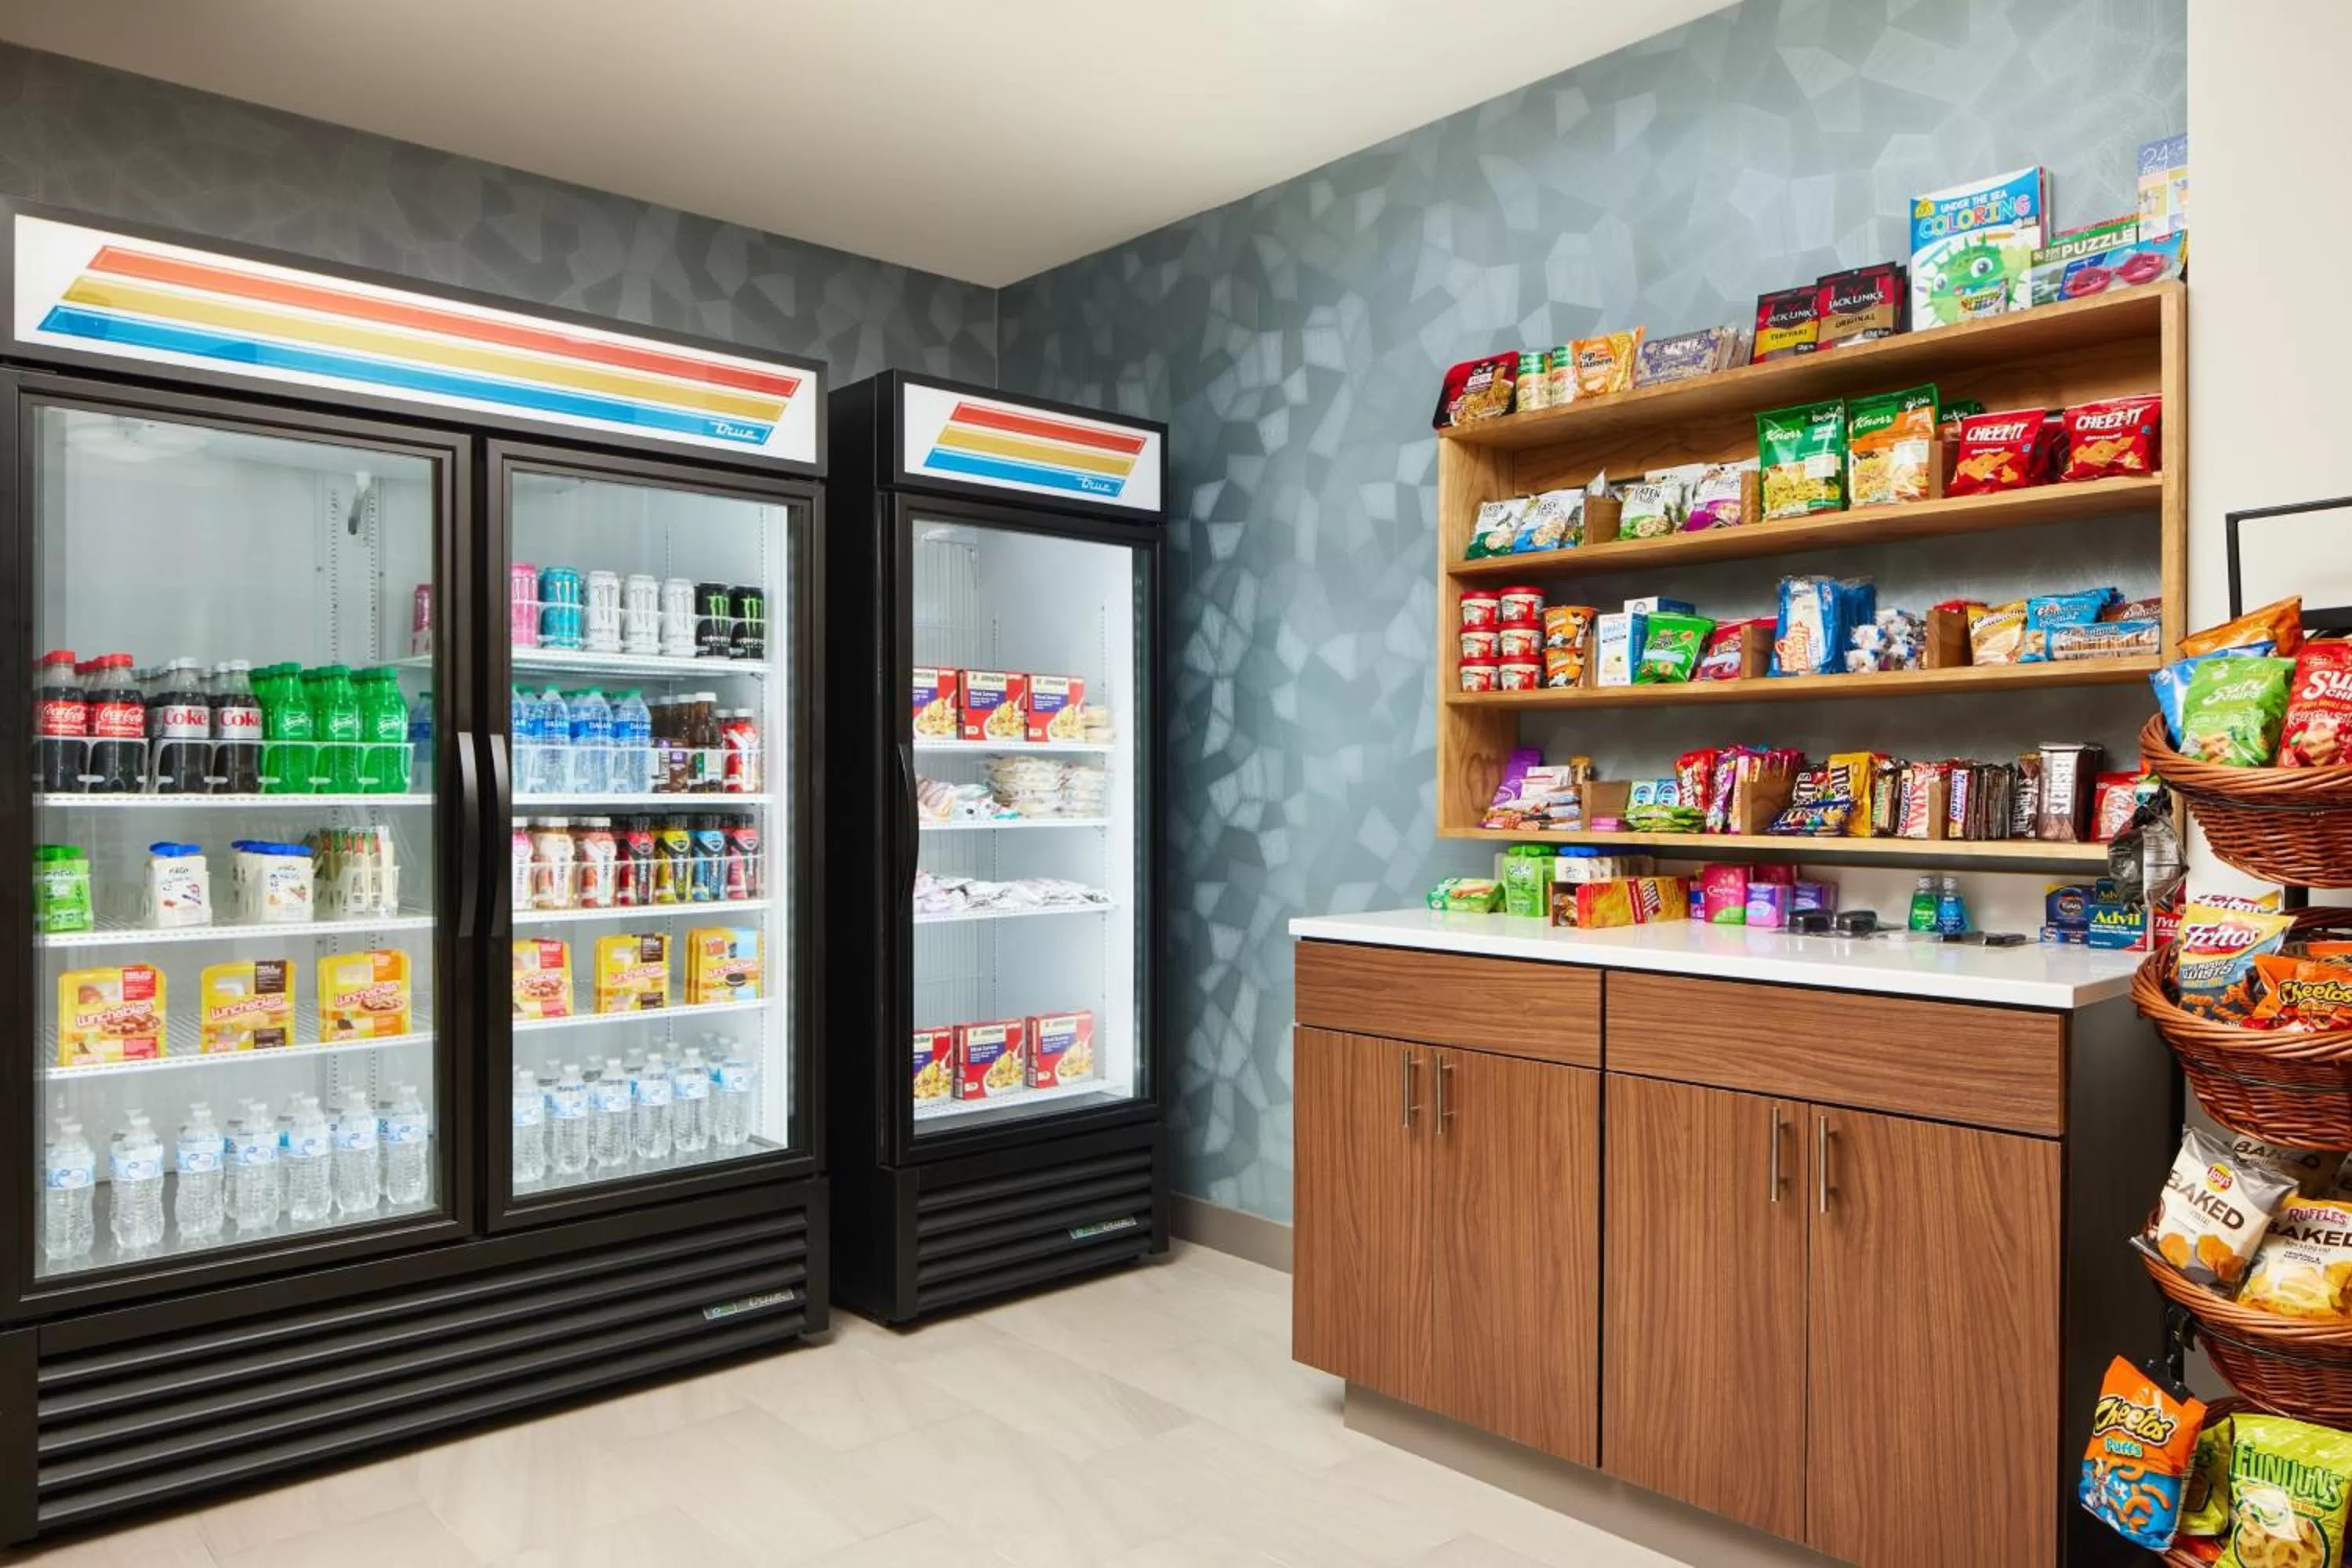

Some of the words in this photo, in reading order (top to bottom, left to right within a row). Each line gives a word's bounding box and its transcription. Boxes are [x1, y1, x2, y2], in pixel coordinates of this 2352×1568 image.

[1973, 194, 1988, 205] THE
[1991, 189, 2008, 200] SEA
[1919, 194, 2031, 238] COLORING
[2062, 228, 2133, 258] PUZZLE
[1828, 296, 1853, 310] JACK
[1853, 291, 1885, 303] LINK'S
[1835, 313, 1875, 328] ORIGINAL
[1855, 414, 1893, 430] Knorr
[2076, 407, 2147, 430] CHEEZ-IT
[1965, 423, 2028, 442] CHEEZ-IT
[2301, 670, 2352, 700] Su
[43, 703, 86, 722] Coca-Cola
[100, 705, 144, 724] Coca-Cola
[162, 708, 208, 726] Coke
[2101, 890, 2119, 901] Adv
[2092, 909, 2142, 926] Advil
[2183, 924, 2260, 951] Fritos
[2280, 981, 2352, 1004] Cheetos
[76, 1001, 154, 1027] Lunchables
[2208, 1166, 2234, 1189] Lay's
[2166, 1169, 2245, 1230] BAKED
[2288, 1208, 2347, 1226] RUFFLES
[2094, 1398, 2172, 1443] Cheetos
[2105, 1436, 2143, 1457] Puffs
[2231, 1439, 2344, 1511] FUNYUNS
